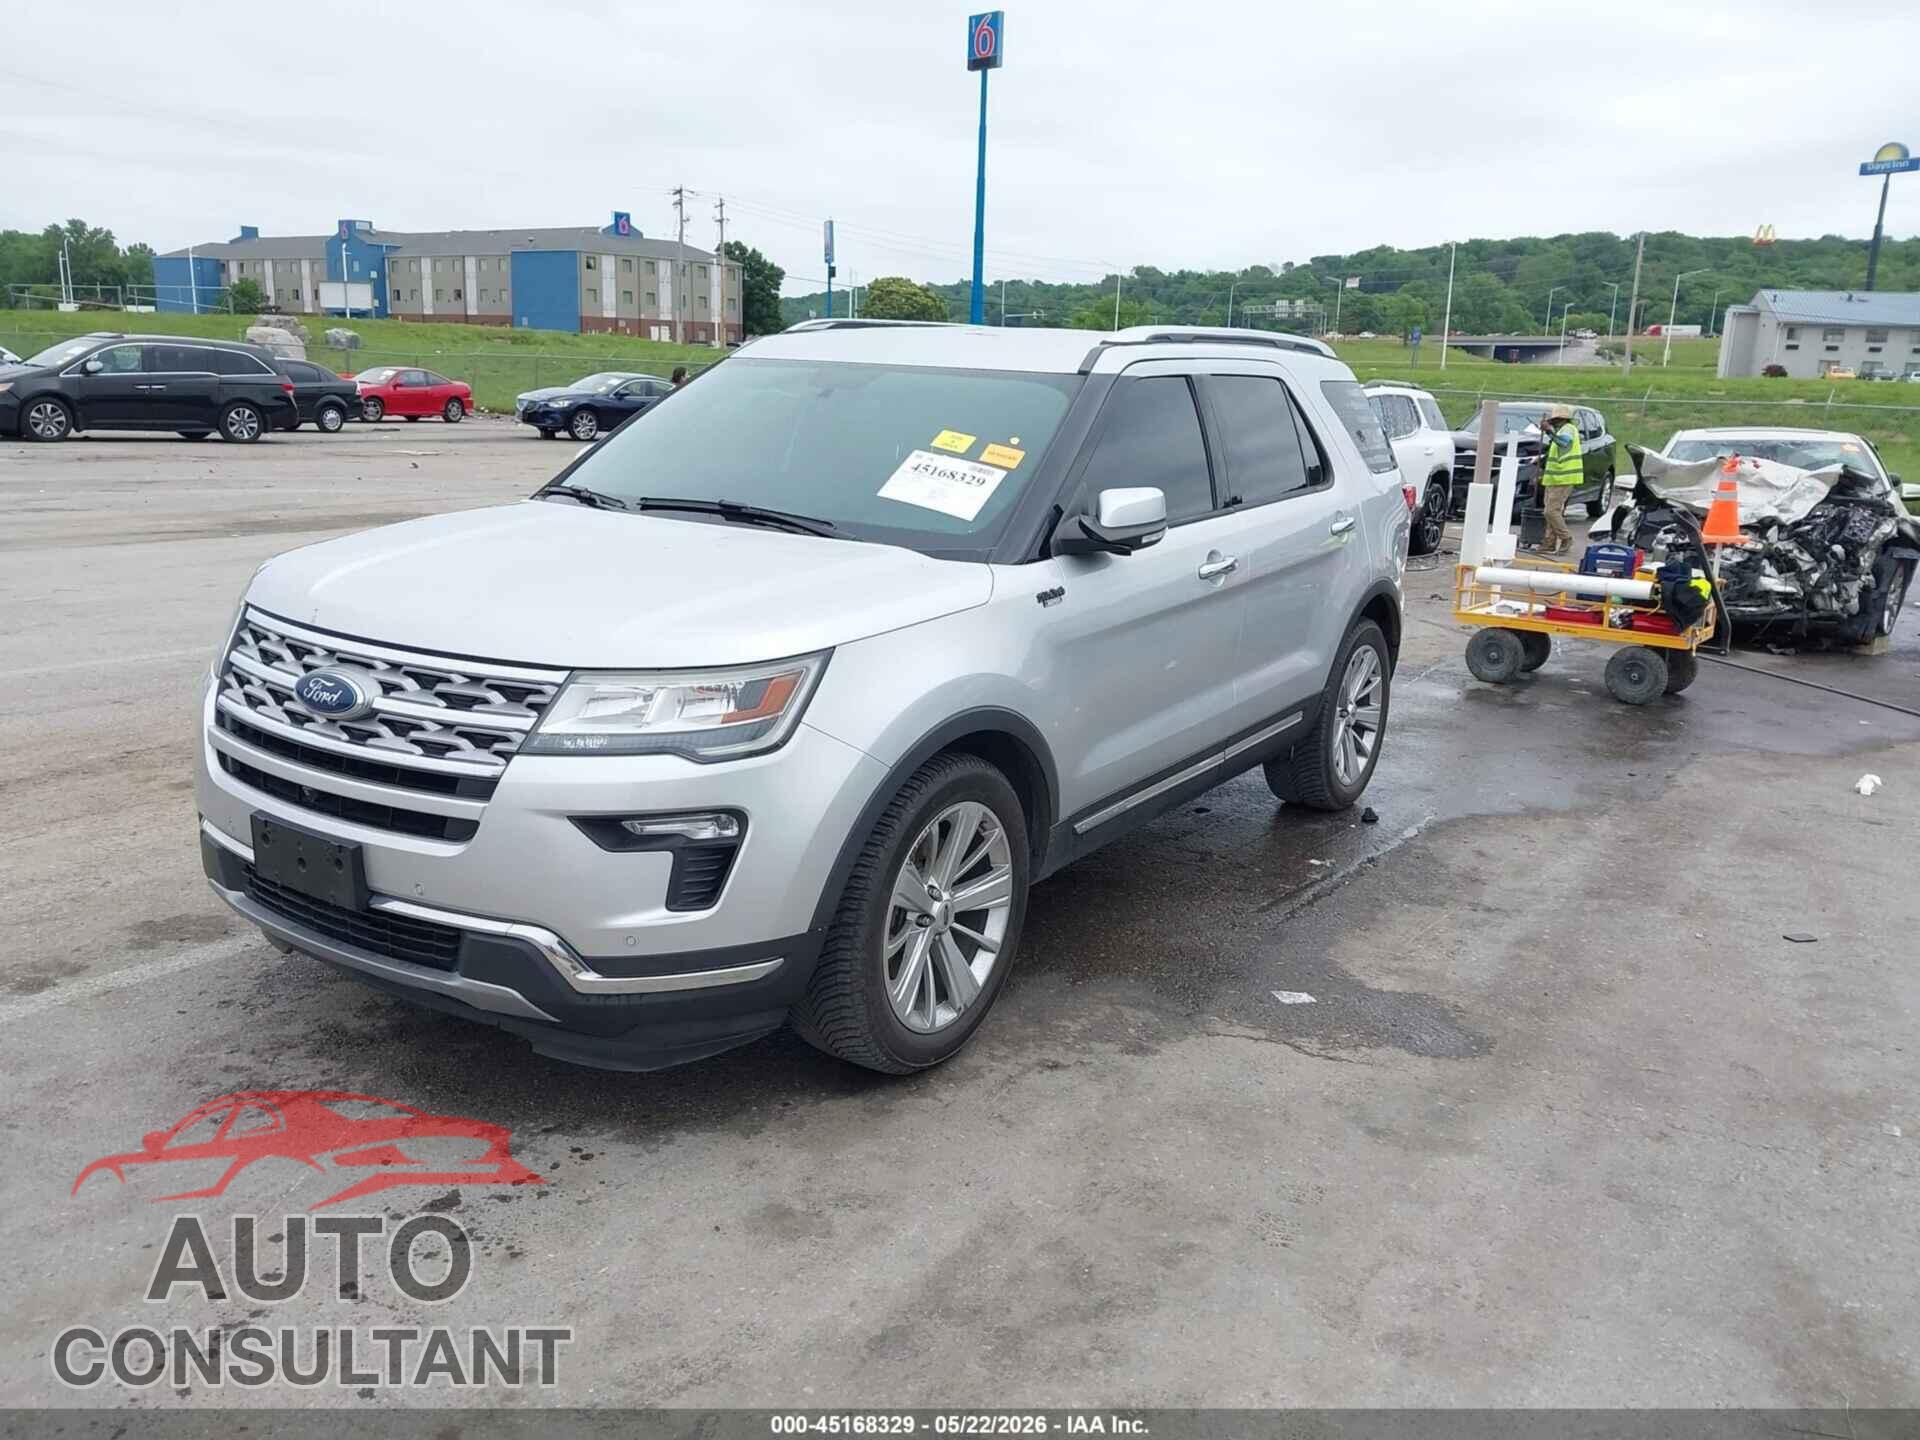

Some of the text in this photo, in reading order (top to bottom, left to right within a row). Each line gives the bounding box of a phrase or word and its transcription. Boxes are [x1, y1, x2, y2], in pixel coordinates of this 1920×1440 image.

[974, 14, 995, 58] 6
[619, 215, 629, 233] 6
[911, 462, 987, 487] 45168329
[303, 677, 343, 705] Ford
